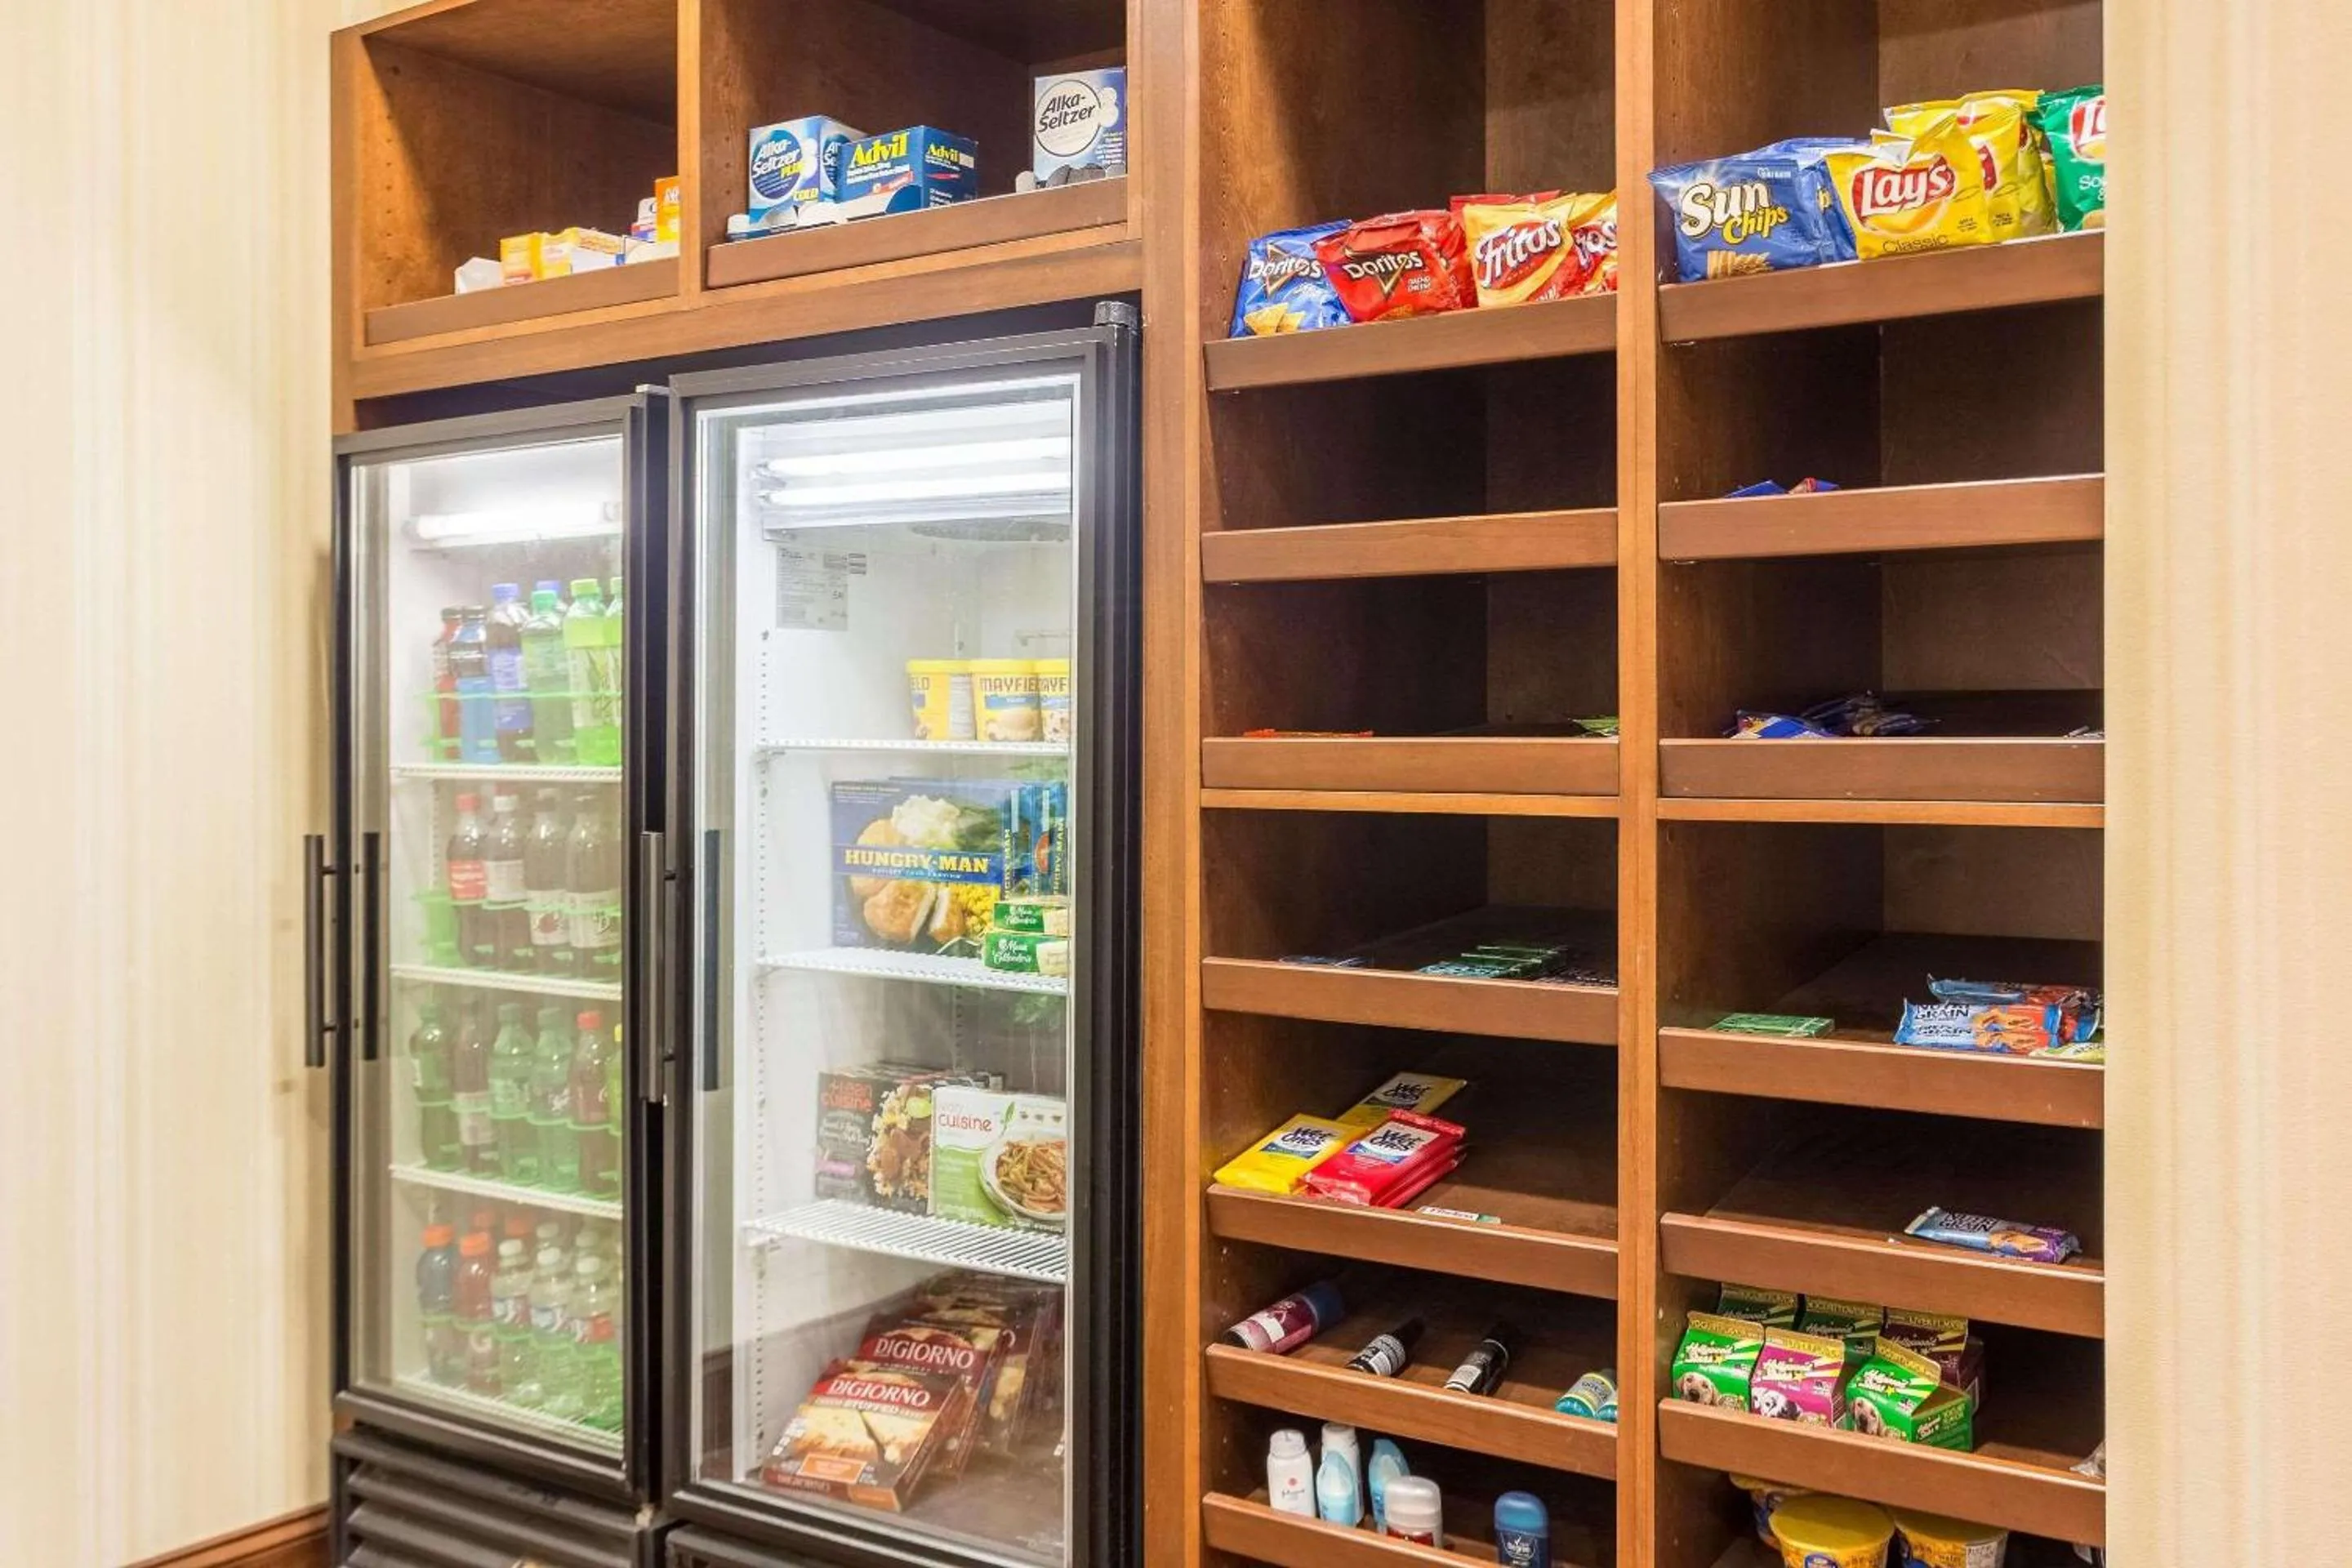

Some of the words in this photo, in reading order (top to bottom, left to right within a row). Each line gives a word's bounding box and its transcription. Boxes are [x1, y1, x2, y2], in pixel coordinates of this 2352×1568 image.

[1042, 94, 1085, 116] Alka-
[1038, 105, 1095, 132] Seltzer
[849, 130, 910, 168] Advil
[927, 143, 960, 163] Advil
[1681, 182, 1771, 238] Sun
[1474, 219, 1562, 289] Fritos
[1882, 234, 1949, 252] Classic
[1248, 256, 1324, 280] Doritos
[1342, 251, 1423, 279] Doritos
[981, 677, 1038, 692] MAYFIE
[938, 1113, 992, 1132] cuisine
